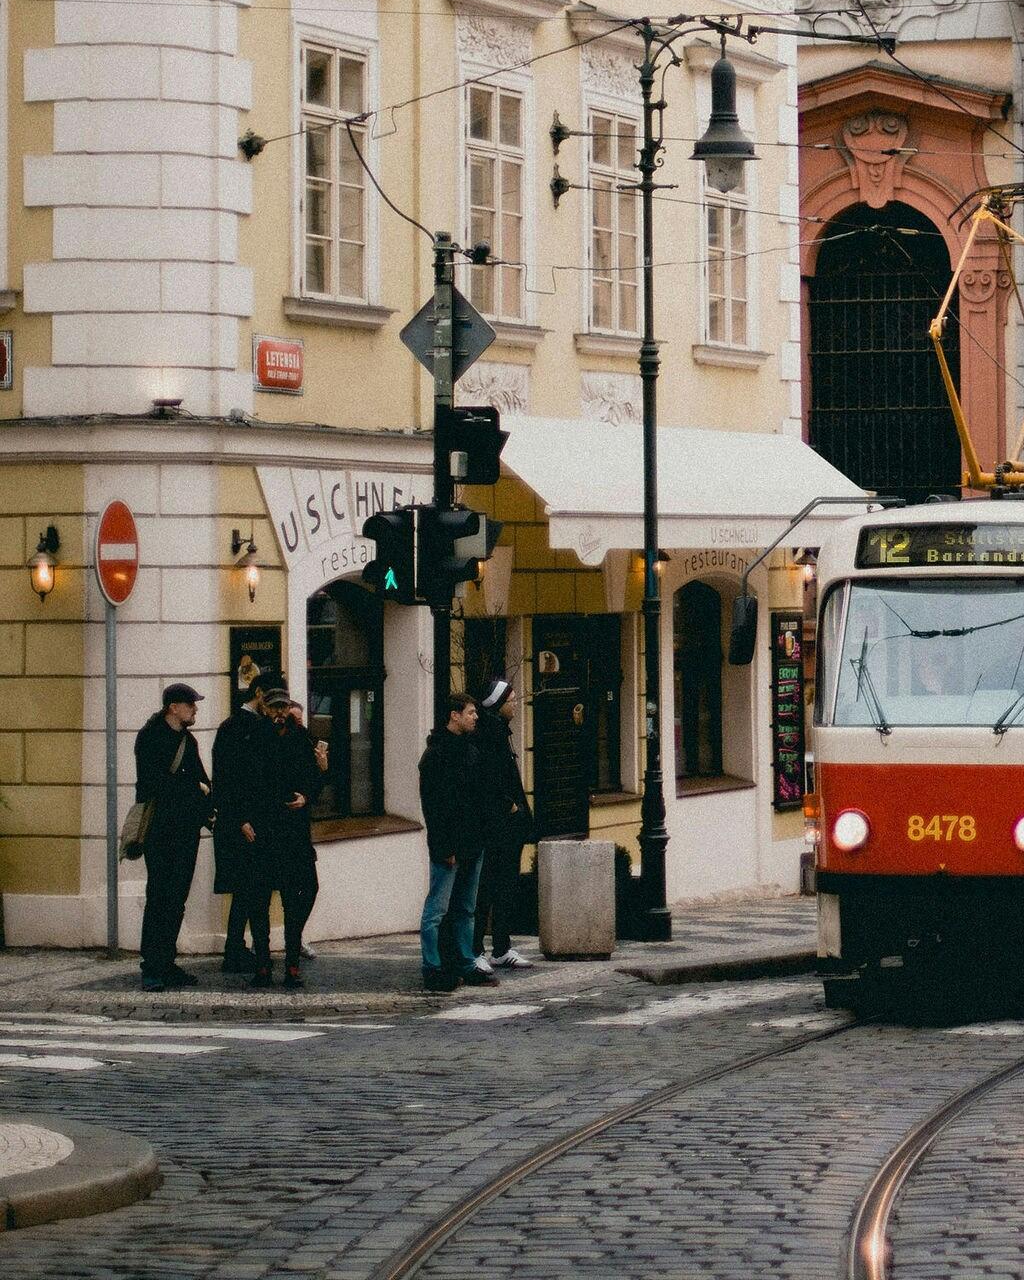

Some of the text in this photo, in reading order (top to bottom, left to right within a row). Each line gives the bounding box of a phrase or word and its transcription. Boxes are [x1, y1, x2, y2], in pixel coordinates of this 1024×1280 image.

[281, 511, 299, 553] U
[869, 528, 910, 564] 12
[907, 815, 977, 841] 8478
